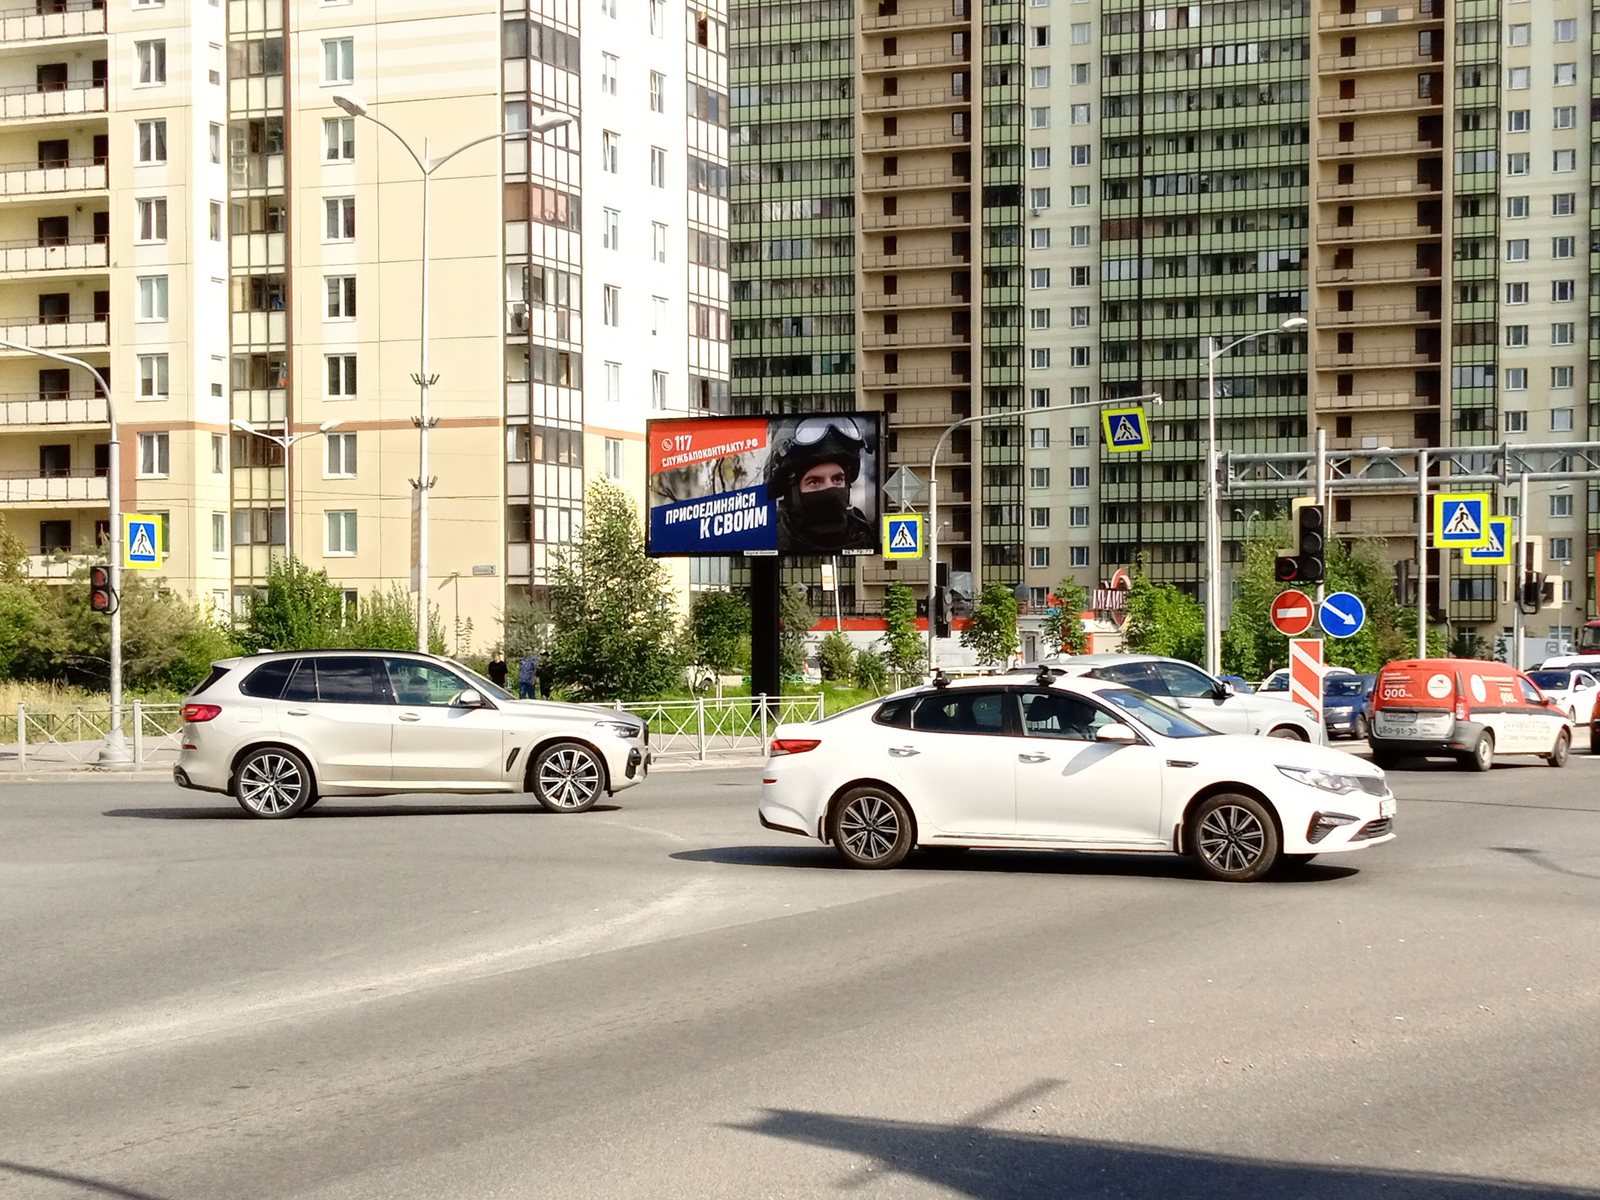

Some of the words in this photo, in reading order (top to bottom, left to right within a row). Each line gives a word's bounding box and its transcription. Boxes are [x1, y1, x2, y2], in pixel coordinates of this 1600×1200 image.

[661, 438, 758, 467] СЛУЖБАПОКОНТРАКТУ.РФ
[674, 435, 692, 451] 117
[665, 492, 756, 525] ПРИСОЕДИНЯЙСЯ
[700, 517, 711, 539] К
[713, 505, 768, 536] СВОИМ
[1384, 689, 1406, 700] 900
